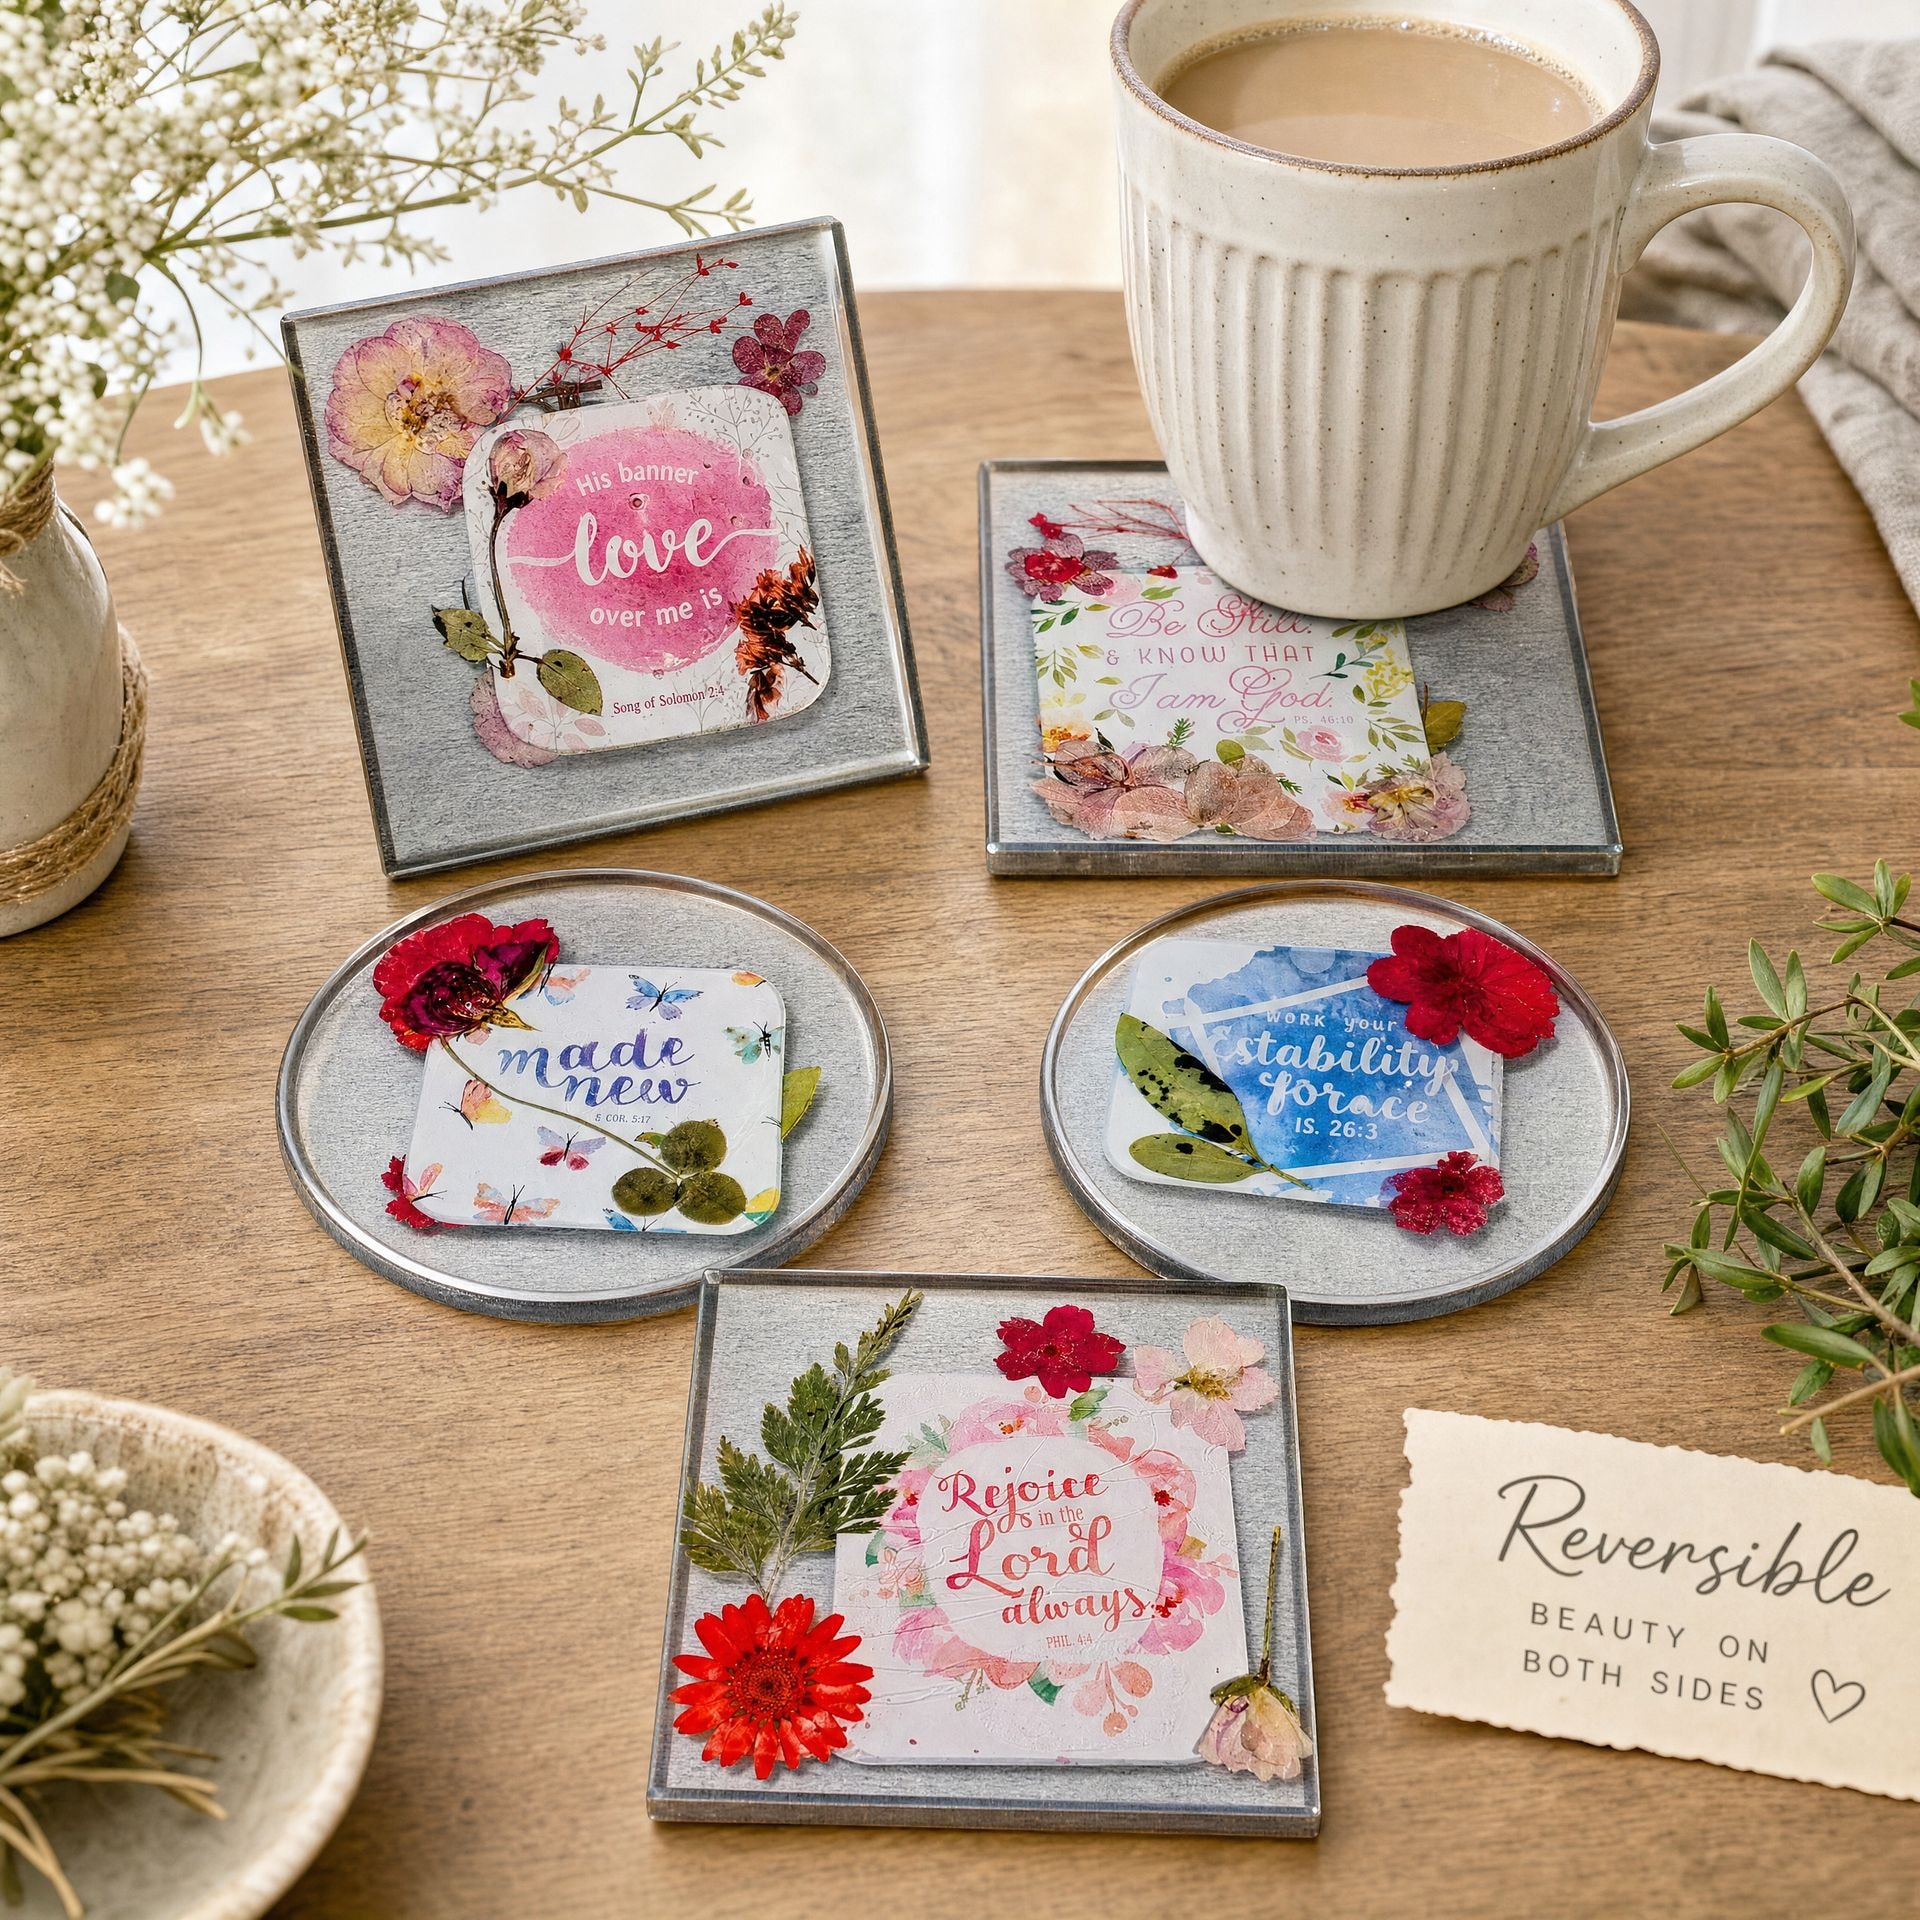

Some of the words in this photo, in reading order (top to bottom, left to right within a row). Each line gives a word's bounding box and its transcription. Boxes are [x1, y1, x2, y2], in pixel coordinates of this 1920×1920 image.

[576, 470, 612, 496] His
[618, 462, 699, 487] banner
[589, 605, 646, 628] over
[656, 602, 694, 626] me
[700, 585, 723, 608] is
[1106, 599, 1187, 638] Be
[1106, 649, 1120, 666] &
[1138, 646, 1226, 665] KNOW
[1244, 645, 1314, 662] THAT
[613, 702, 640, 715] Song
[644, 696, 656, 709] of
[660, 691, 705, 707] Solomon
[707, 685, 725, 698] 2:4
[1109, 672, 1167, 710] I
[1156, 692, 1226, 709] am
[1266, 1010, 1326, 1027] WORK
[1344, 1016, 1398, 1032] your
[497, 1027, 695, 1088] made
[565, 1075, 701, 1107] new
[605, 1113, 628, 1123] COR.
[631, 1114, 651, 1124] 5:17
[1295, 1117, 1320, 1135] IS.
[1329, 1119, 1378, 1140] 26:3
[938, 1466, 1109, 1533] Rejoice
[1038, 1509, 1055, 1527] in
[1059, 1505, 1084, 1525] the
[945, 1514, 1114, 1599] Lord
[1497, 1475, 1891, 1607] Reversible
[1046, 1634, 1075, 1648] PHIL.
[1077, 1633, 1093, 1646] 4:4
[1530, 1602, 1686, 1648] BEAUTY
[1719, 1635, 1769, 1664] ON
[1523, 1649, 1623, 1688] BOTH
[1650, 1670, 1765, 1710] SIDES
